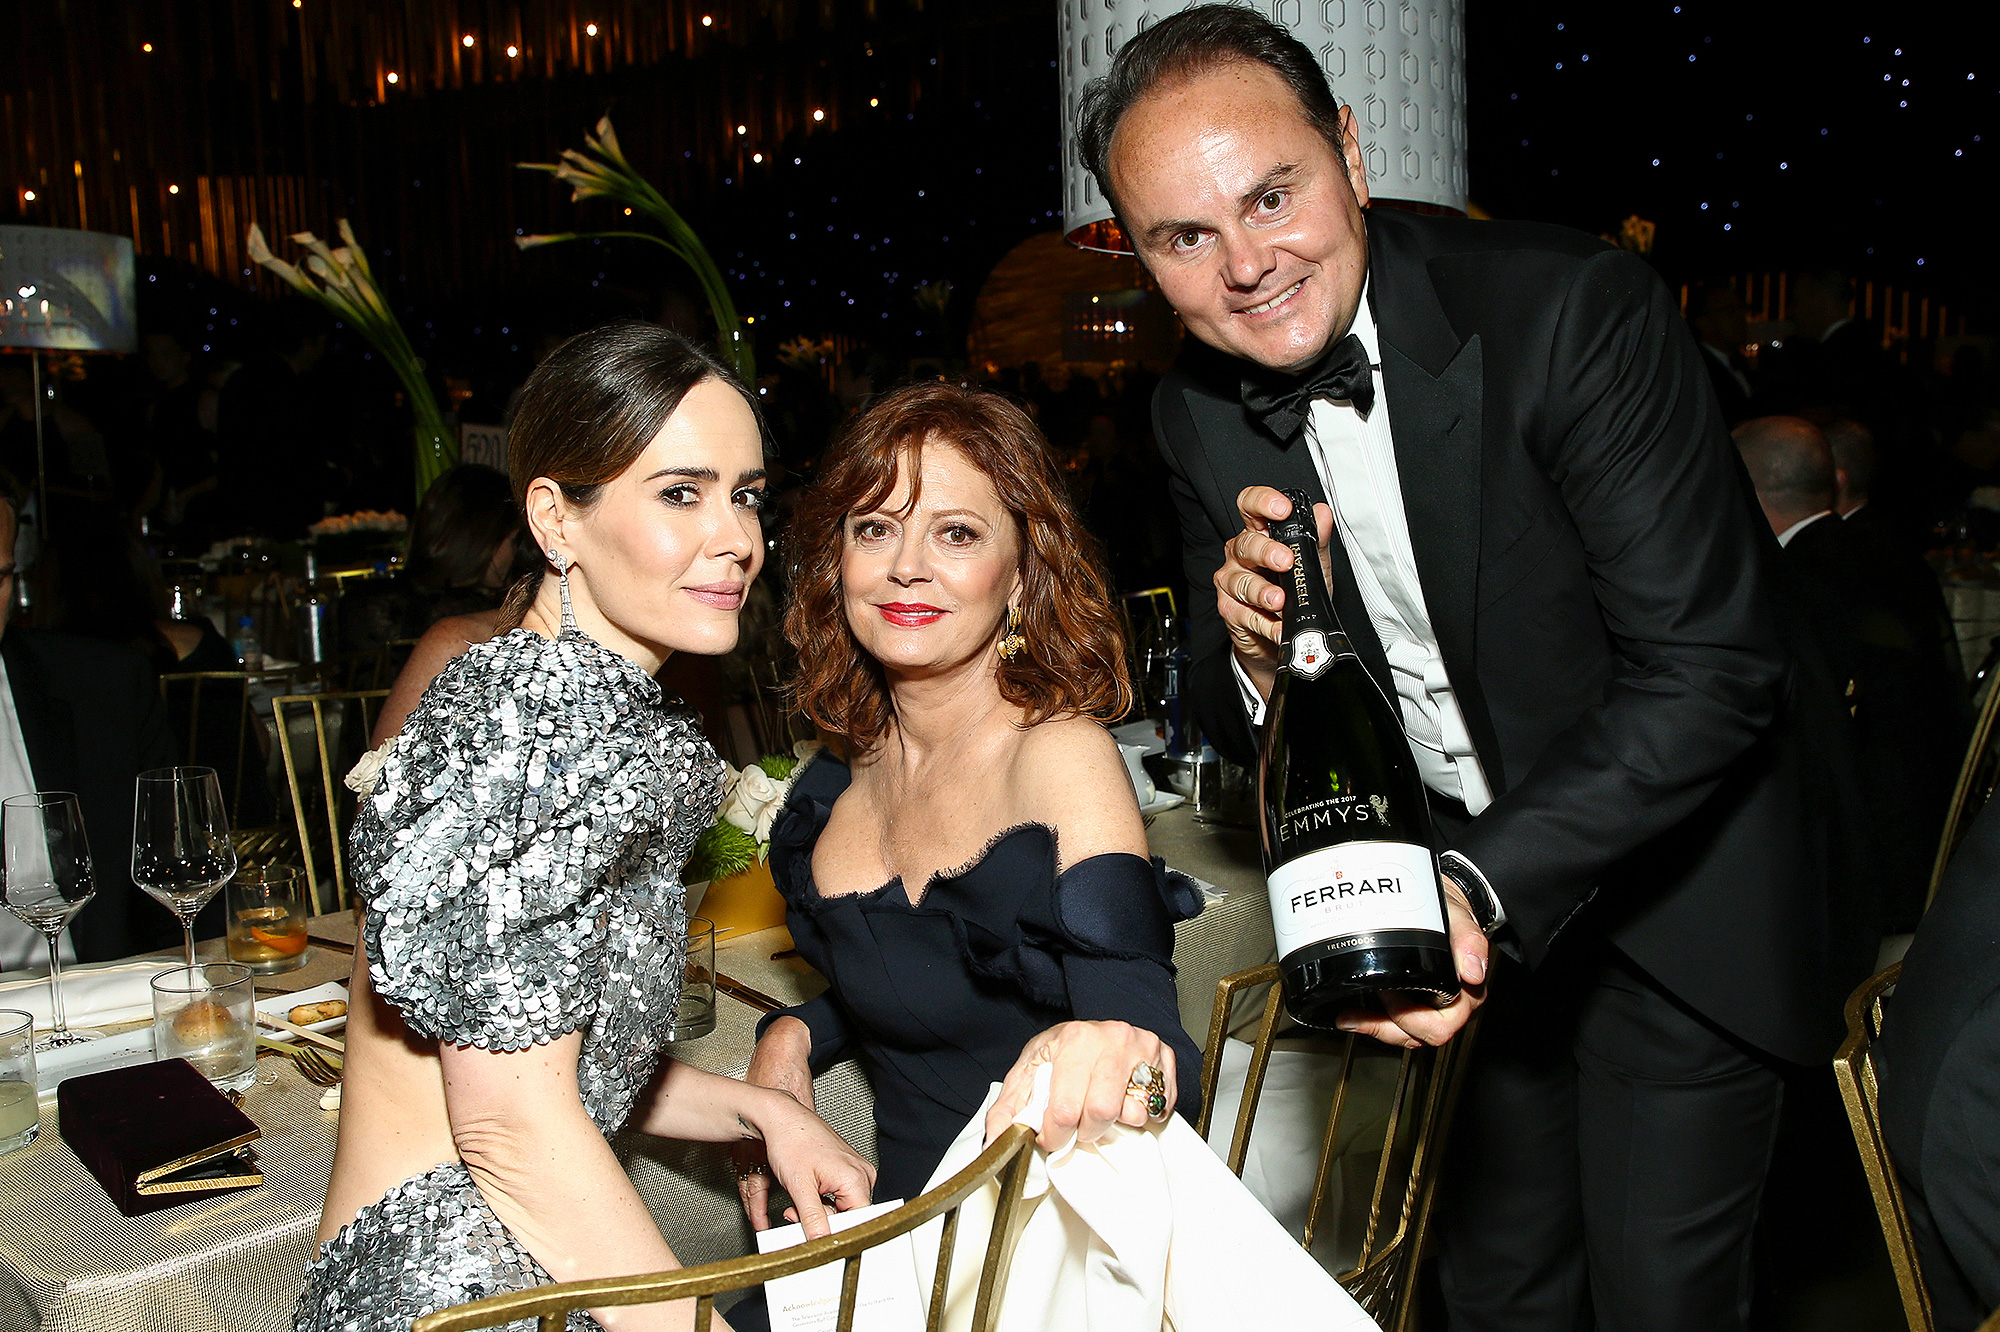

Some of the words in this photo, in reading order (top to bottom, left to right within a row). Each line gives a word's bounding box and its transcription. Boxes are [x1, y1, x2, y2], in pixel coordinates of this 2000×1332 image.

[1289, 542, 1310, 608] FERRARI
[1284, 800, 1325, 819] CELEBRATING
[1325, 797, 1340, 806] THE
[1340, 795, 1357, 803] 2017
[1279, 804, 1370, 842] EMMYS
[1290, 877, 1403, 914] FERRARI
[1324, 901, 1365, 914] BRUT
[1326, 935, 1377, 951] TRENTODOC
